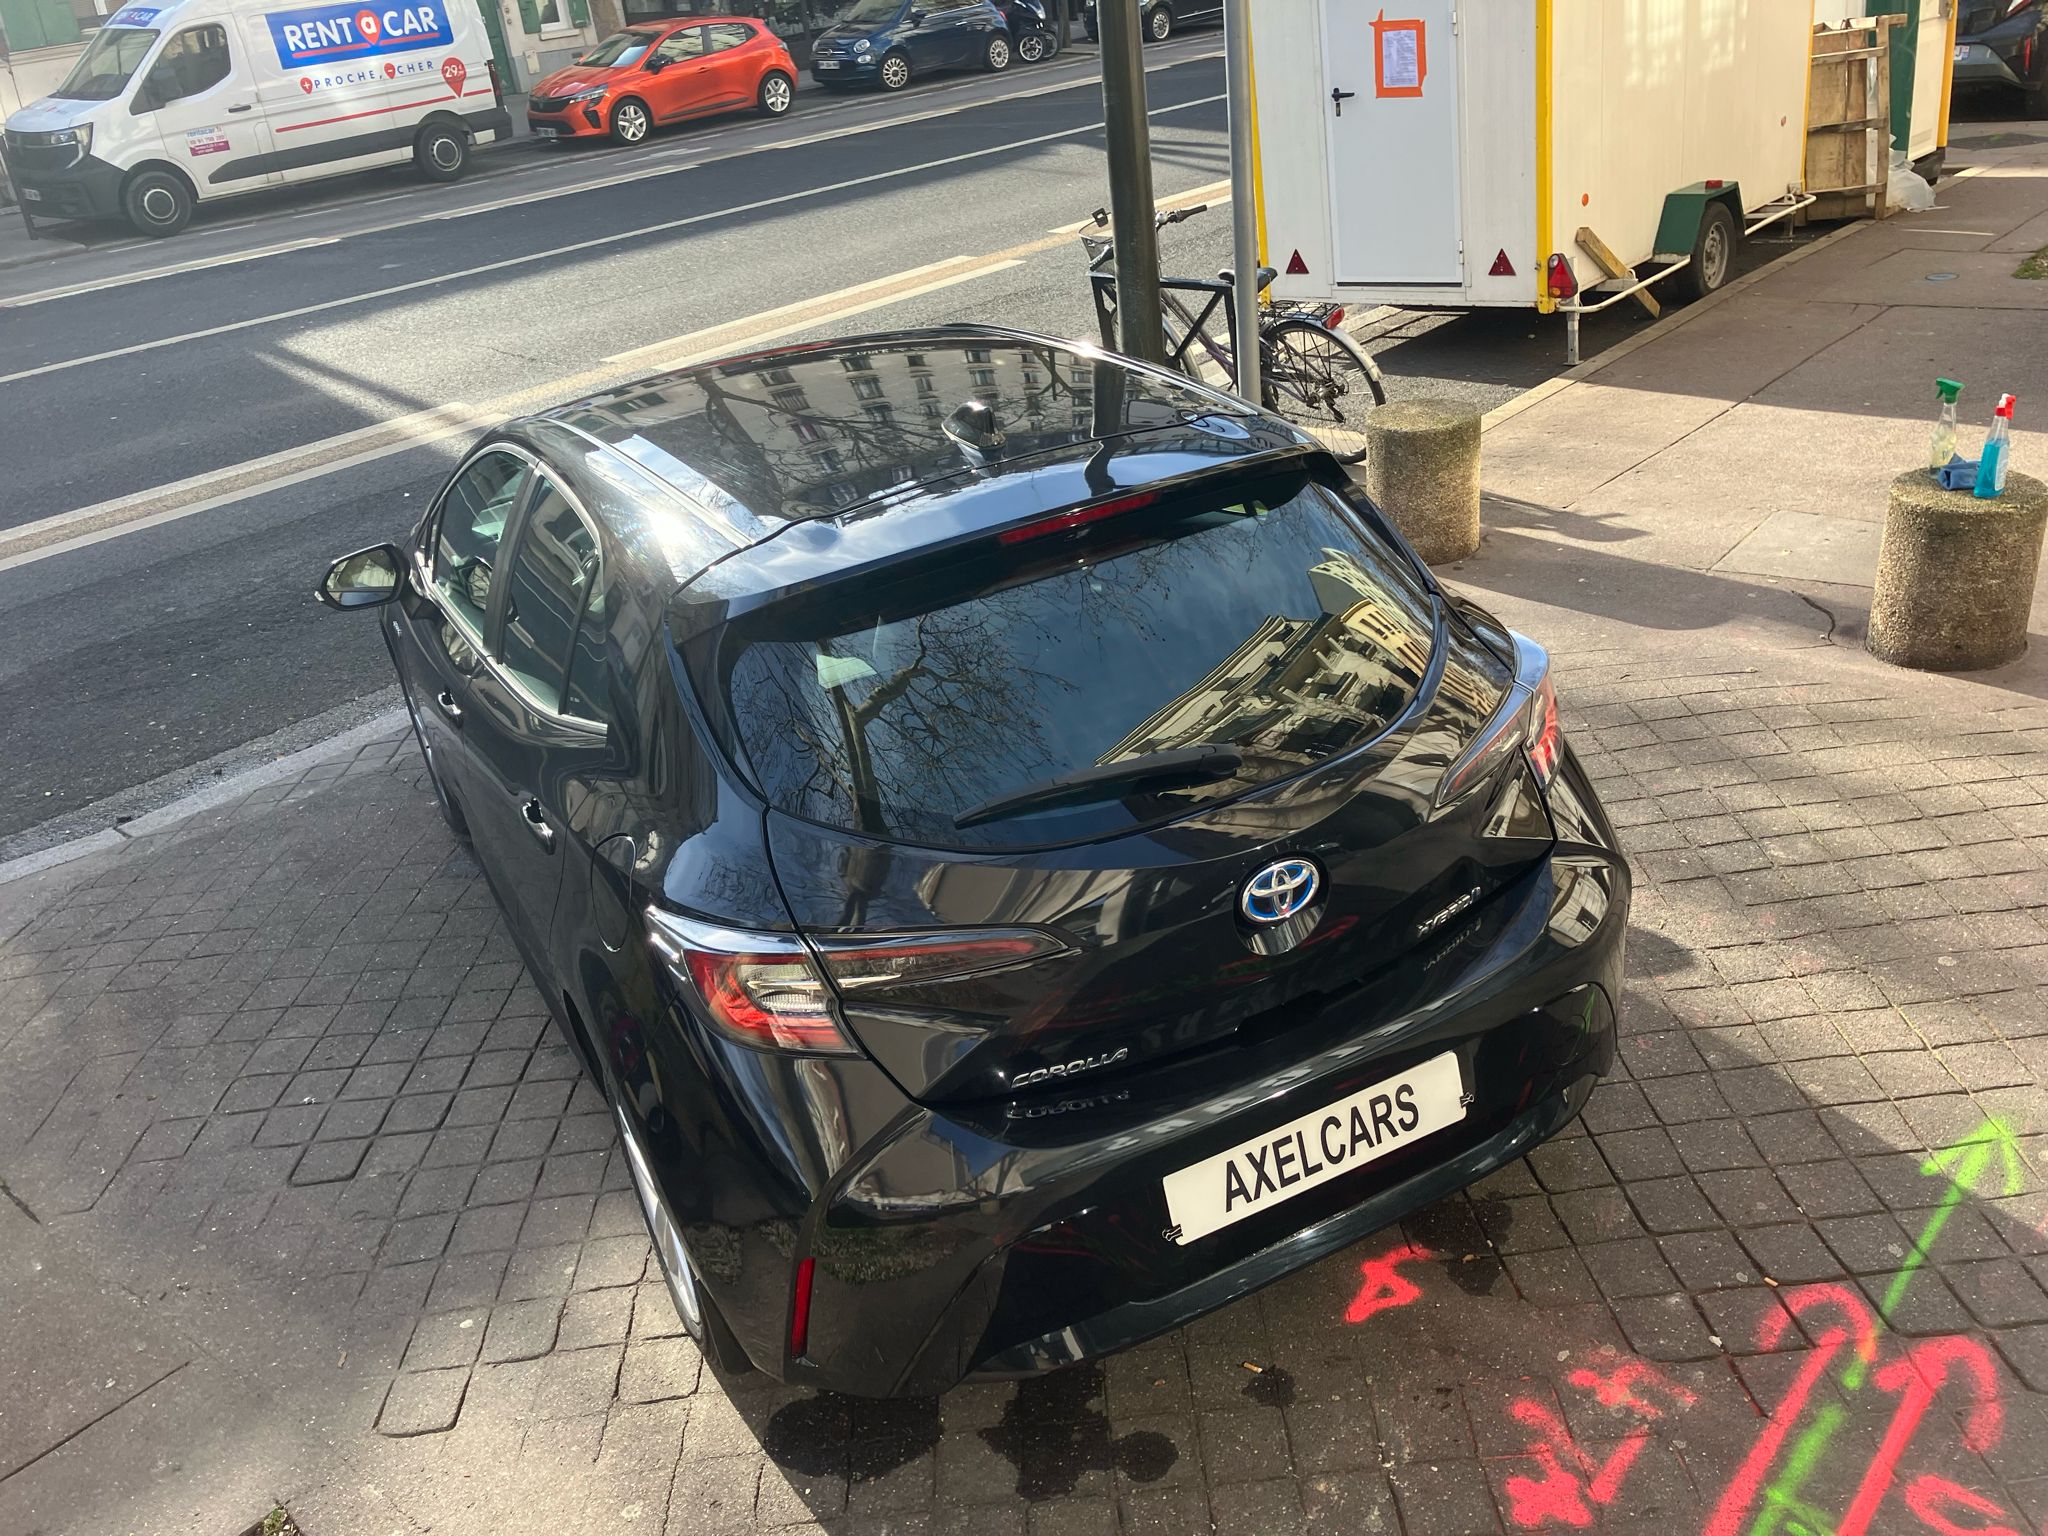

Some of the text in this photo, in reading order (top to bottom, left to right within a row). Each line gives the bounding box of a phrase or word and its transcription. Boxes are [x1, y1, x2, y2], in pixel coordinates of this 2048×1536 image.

[283, 6, 439, 51] RENT a CAR
[315, 70, 383, 89] PROCHE,
[397, 61, 434, 75] CHER
[1010, 1047, 1128, 1089] COROLLA
[1224, 1083, 1420, 1214] AXELCARS
